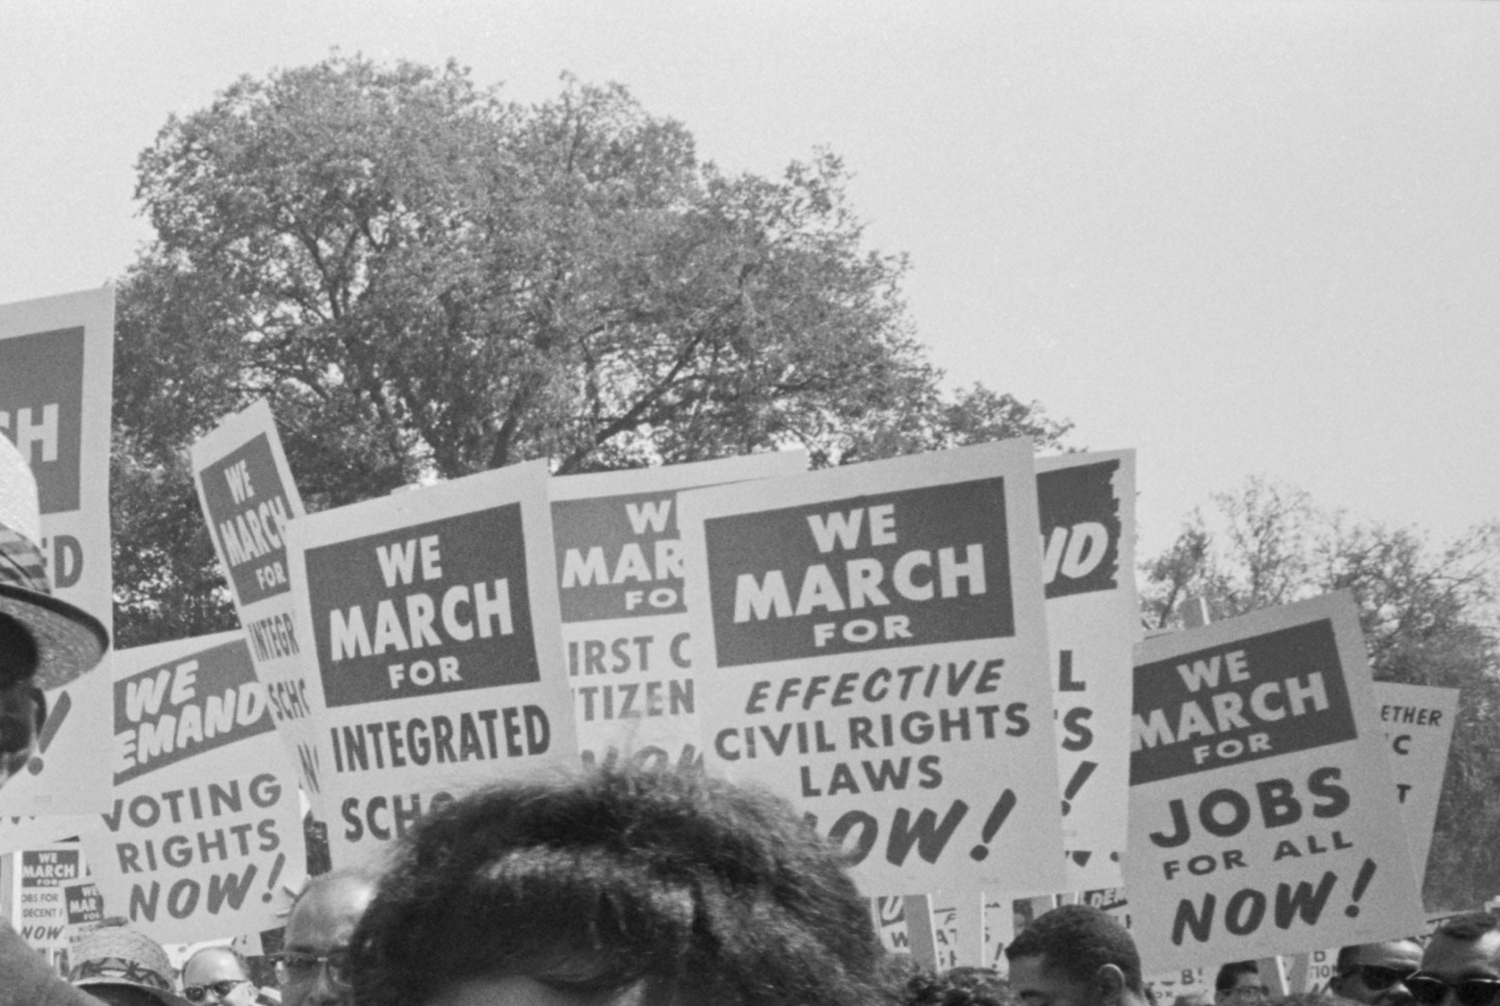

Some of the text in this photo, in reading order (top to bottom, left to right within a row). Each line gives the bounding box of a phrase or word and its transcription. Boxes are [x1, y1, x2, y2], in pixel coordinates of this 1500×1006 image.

[223, 459, 255, 505] WE
[220, 496, 288, 567] MARCH
[625, 500, 672, 534] W
[808, 503, 898, 553] WE
[255, 562, 287, 590] FOR
[376, 535, 443, 587] WE
[562, 539, 685, 588] MAR
[733, 543, 987, 623] MARCH
[329, 577, 514, 662] MARCH
[625, 588, 678, 611] FO
[248, 612, 300, 663] INTEGR
[813, 614, 913, 647] FOR
[389, 656, 463, 690] FOR
[568, 635, 654, 677] IRST
[1176, 649, 1251, 693] WE
[125, 660, 198, 722] WE
[578, 678, 695, 722] TIZEN
[745, 658, 1006, 715] EFFECTIVE
[1132, 671, 1330, 752] MARCH
[114, 681, 268, 775] EMAND
[330, 704, 551, 773] INTEGRATED
[714, 720, 836, 762] CIVIL
[848, 702, 1031, 750] RIGHTS
[1380, 704, 1442, 727] ETHER
[1193, 732, 1272, 764] FOR
[800, 754, 943, 798] LAWS
[102, 773, 282, 832] VOTING
[803, 788, 1017, 867] OW!
[1150, 766, 1351, 849] JOBS
[22, 864, 75, 878] MARCH
[38, 852, 58, 864] WE
[116, 819, 280, 874] RIGHTS
[1163, 830, 1353, 881] FOR ALL
[21, 893, 38, 903] OBS
[69, 898, 98, 914] MAR
[129, 852, 285, 922] NOW!
[1172, 857, 1377, 946] NOW!
[22, 908, 57, 918] DECENT
